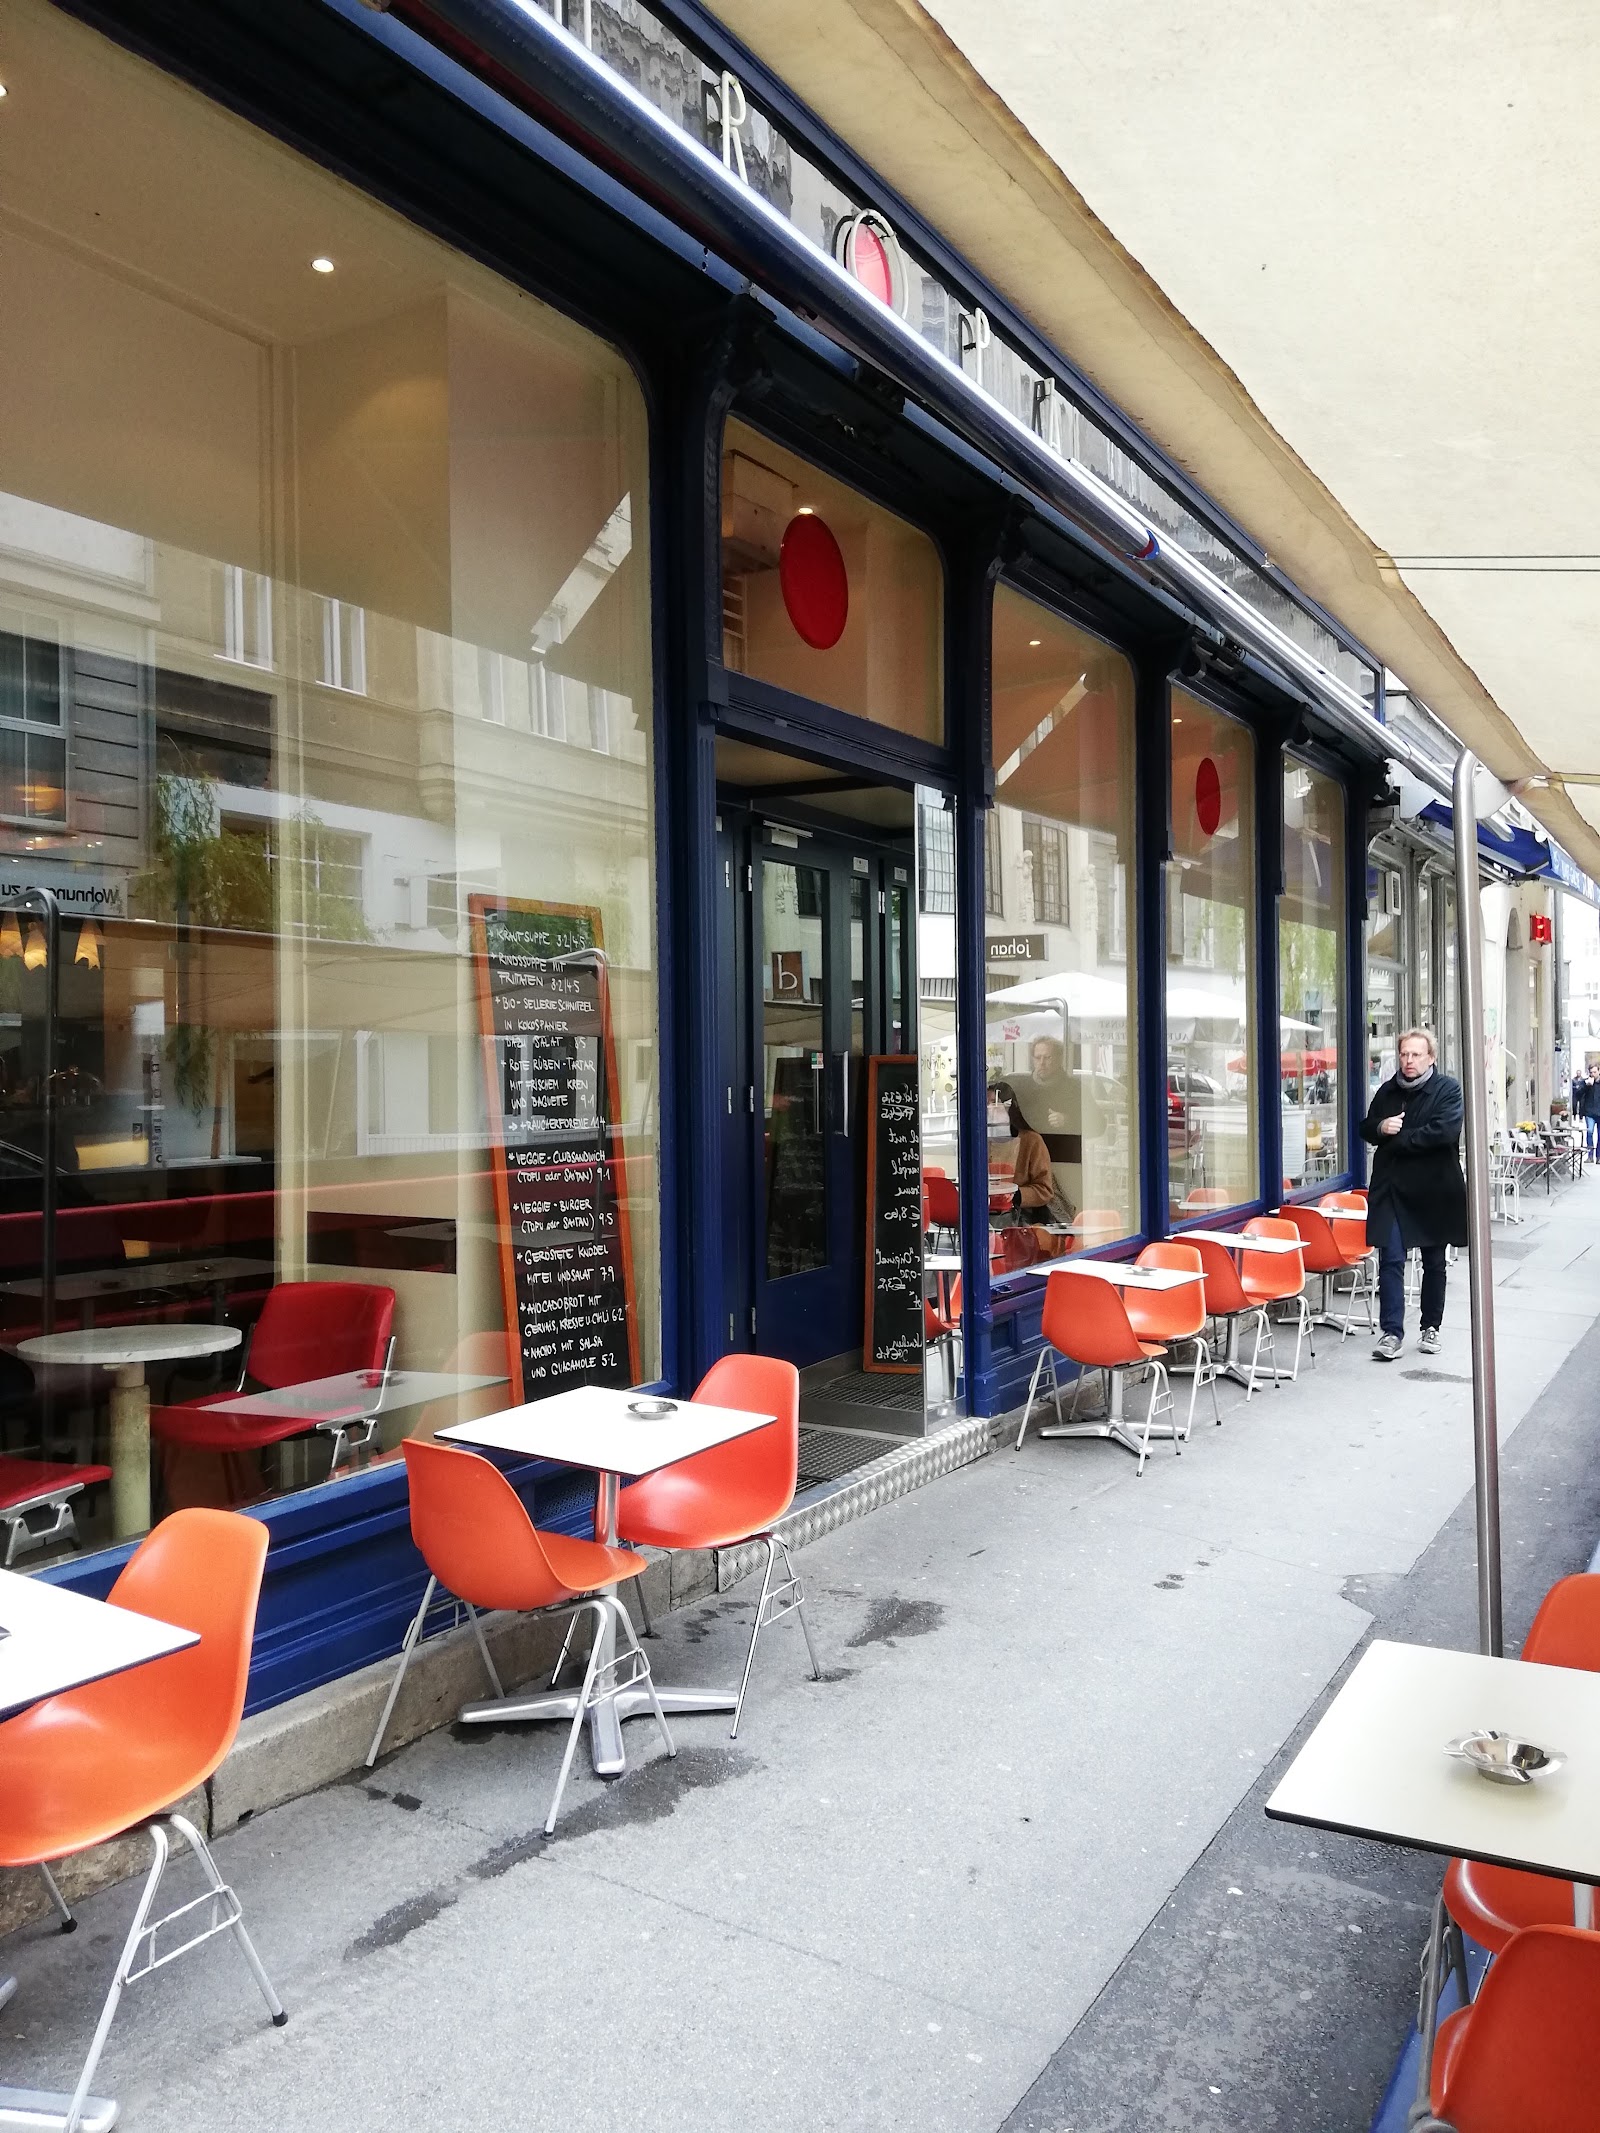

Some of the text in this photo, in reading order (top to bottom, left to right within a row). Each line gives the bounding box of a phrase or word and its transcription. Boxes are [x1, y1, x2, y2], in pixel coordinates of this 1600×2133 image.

[553, 962, 567, 972] MIT
[504, 1018, 569, 1031] IN KOKOSPANIER
[533, 1035, 563, 1049] SALAT
[509, 1058, 530, 1072] ROTE
[509, 1079, 524, 1091] MIT
[566, 1079, 588, 1090] KREN
[511, 1097, 527, 1110] UND
[524, 1242, 609, 1265] GERÖSTETE KNÖDEL
[588, 1294, 602, 1306] MIT
[559, 1316, 584, 1330] KRESSE
[530, 1335, 603, 1359] NACHOS MIT SALSA
[531, 1366, 546, 1378] UND
[551, 1357, 596, 1375] GUACAMOLE
